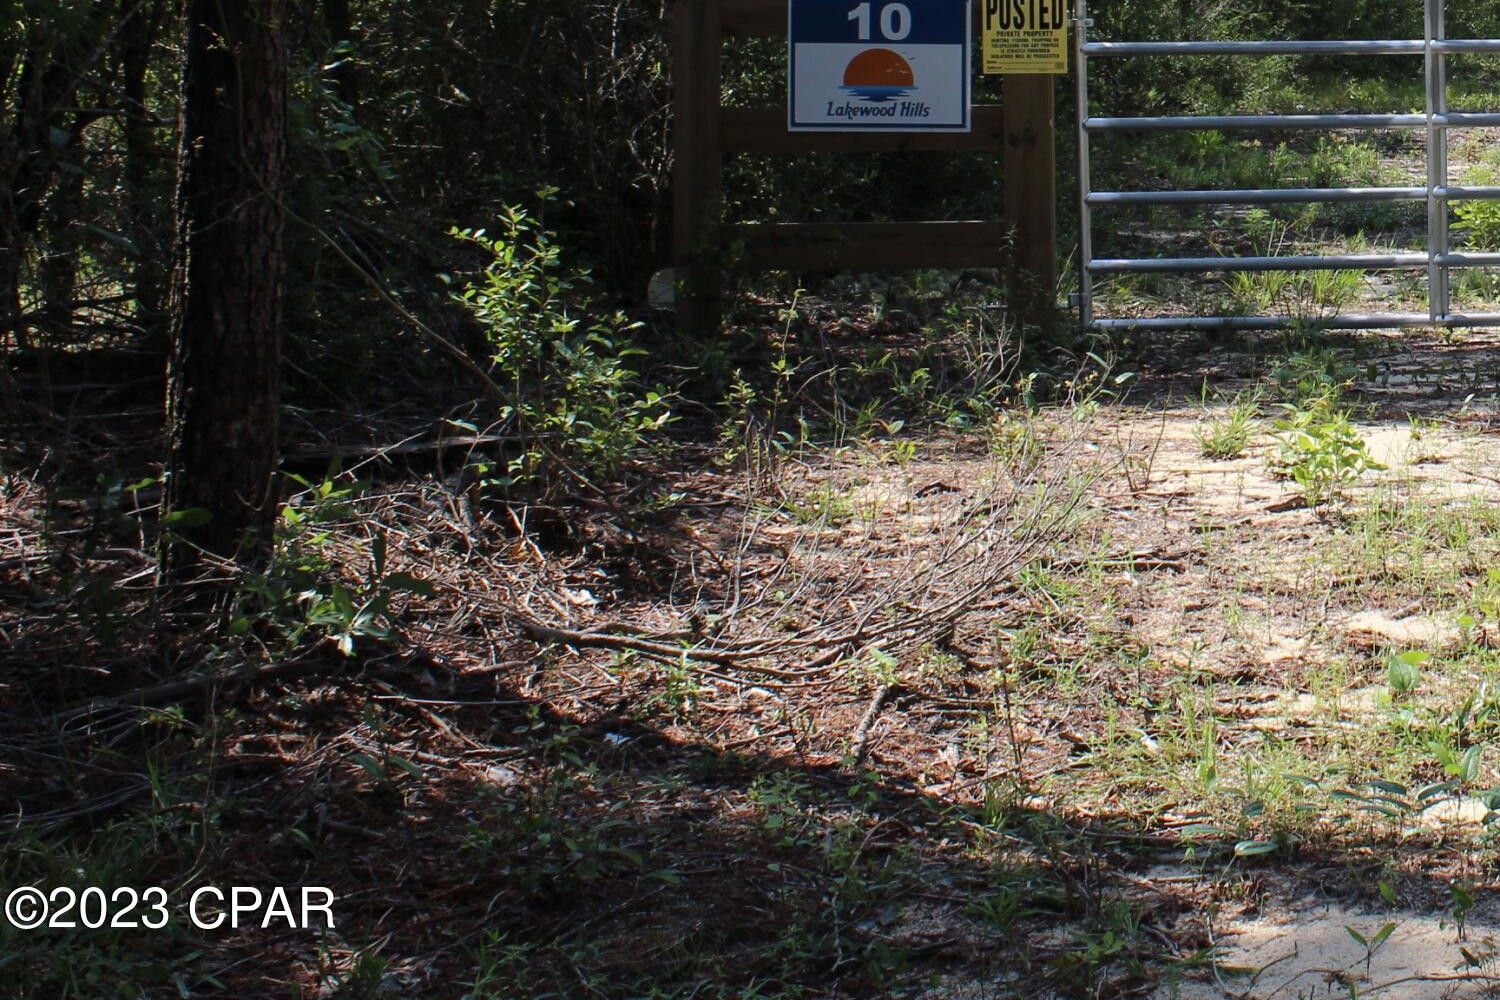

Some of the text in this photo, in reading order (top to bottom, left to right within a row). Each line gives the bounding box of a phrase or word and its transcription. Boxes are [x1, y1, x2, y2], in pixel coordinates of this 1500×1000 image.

[848, 2, 912, 41] 10
[826, 101, 931, 120] Lakewood Hills
